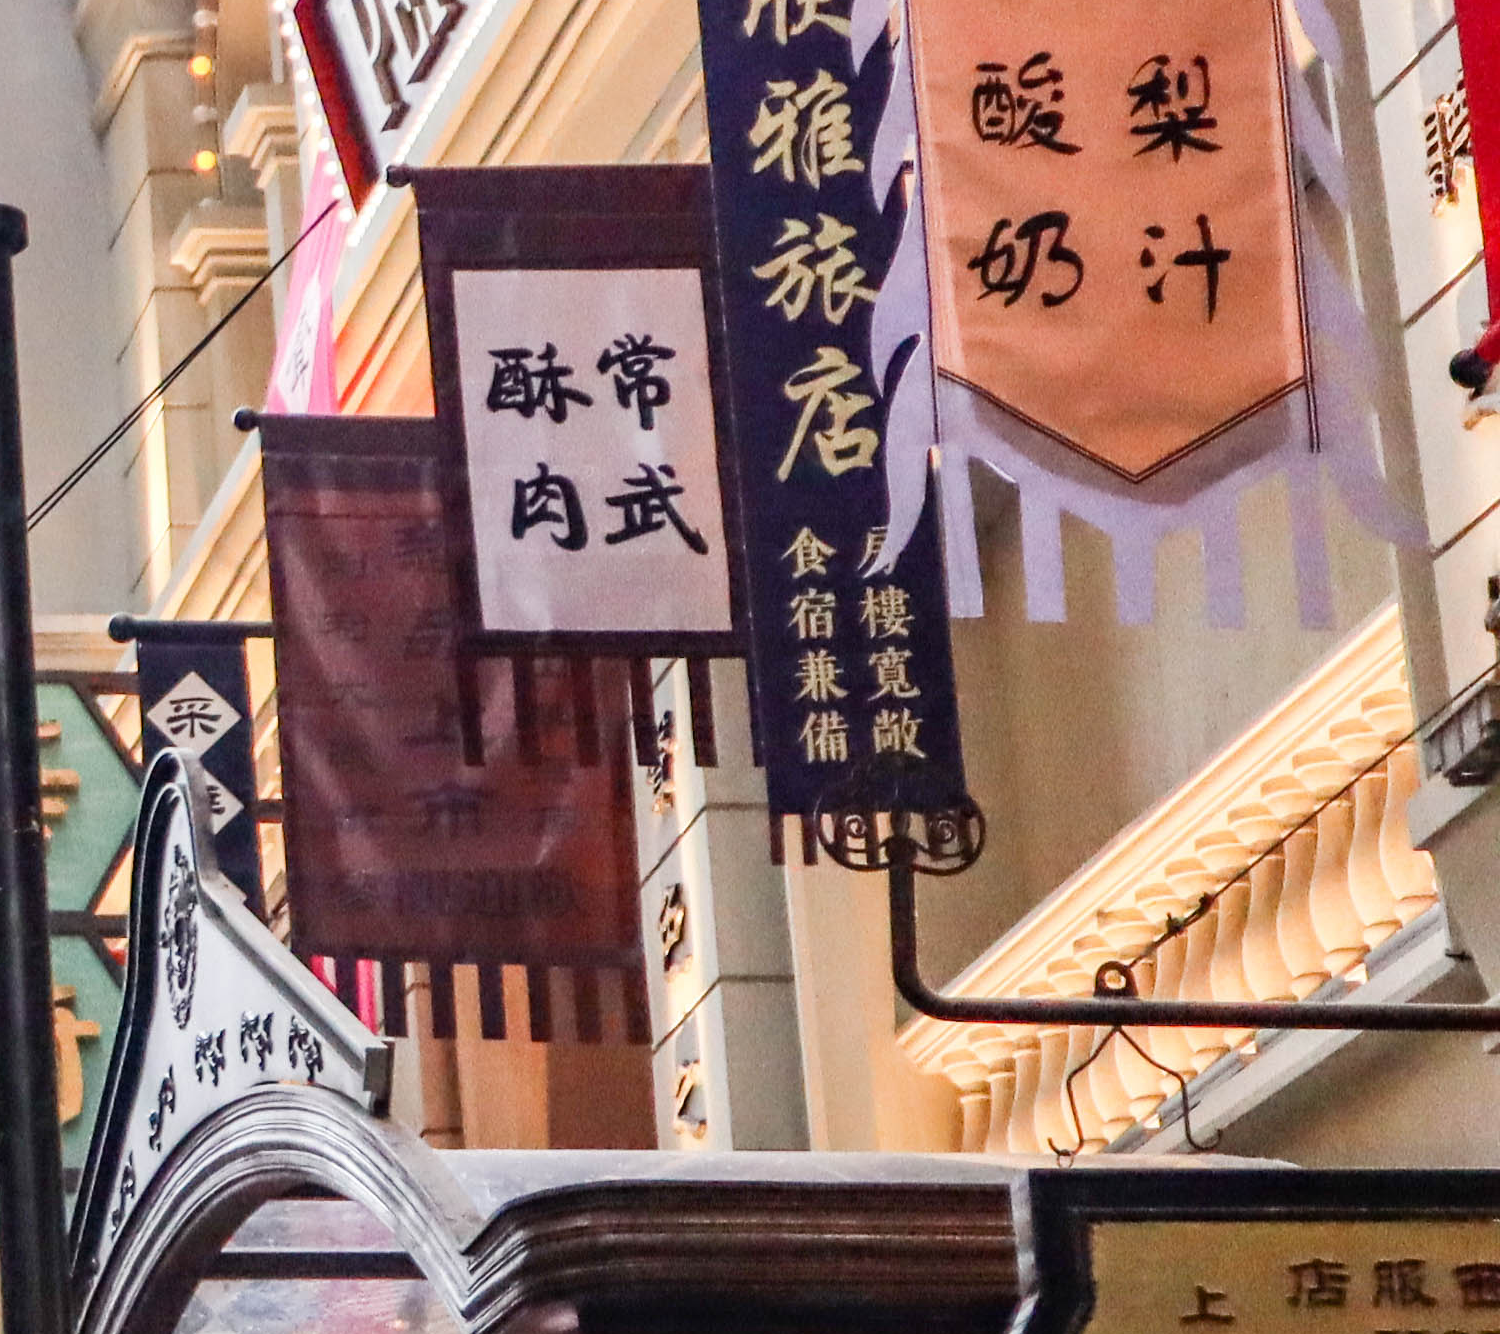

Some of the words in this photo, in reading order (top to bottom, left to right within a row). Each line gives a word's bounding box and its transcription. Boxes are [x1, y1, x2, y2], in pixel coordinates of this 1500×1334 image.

[486, 340, 594, 553] 酥肉
[596, 335, 710, 557] 常武
[783, 526, 849, 764] 食宿兼備
